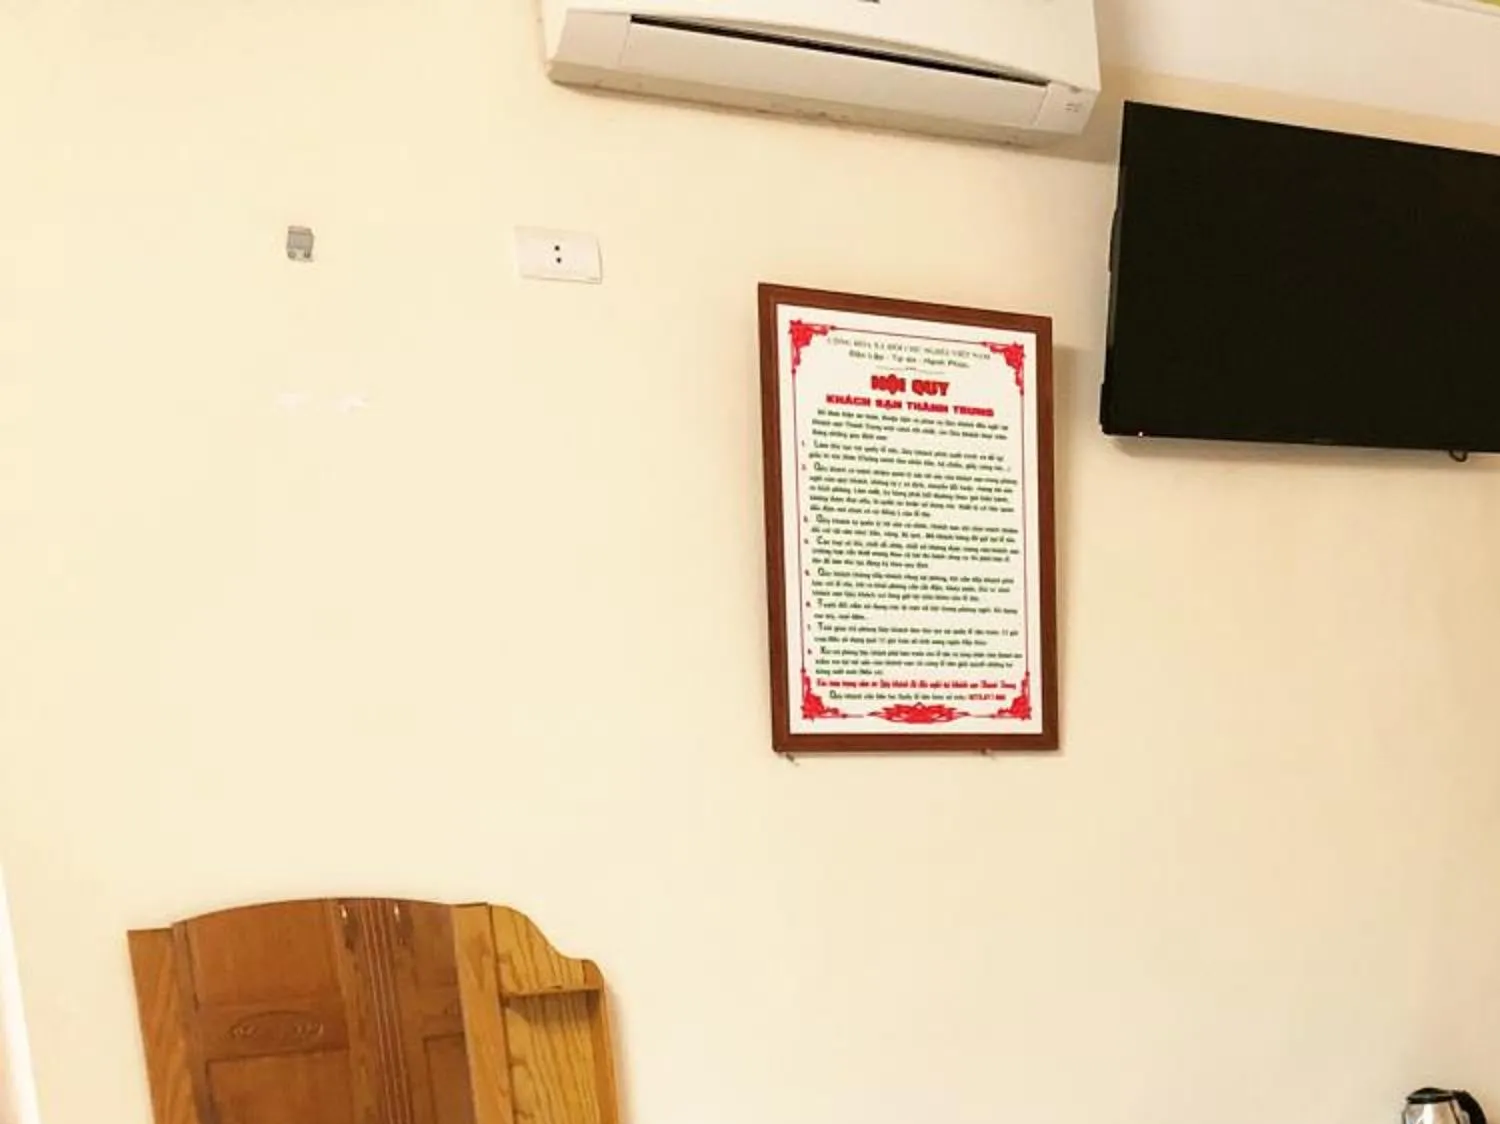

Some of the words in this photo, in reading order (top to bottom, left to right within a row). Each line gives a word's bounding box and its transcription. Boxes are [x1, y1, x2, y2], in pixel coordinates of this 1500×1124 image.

[871, 374, 906, 394] NỘI
[912, 379, 950, 396] QUY
[826, 394, 871, 407] KHÁCH
[953, 405, 995, 417] TRUNG
